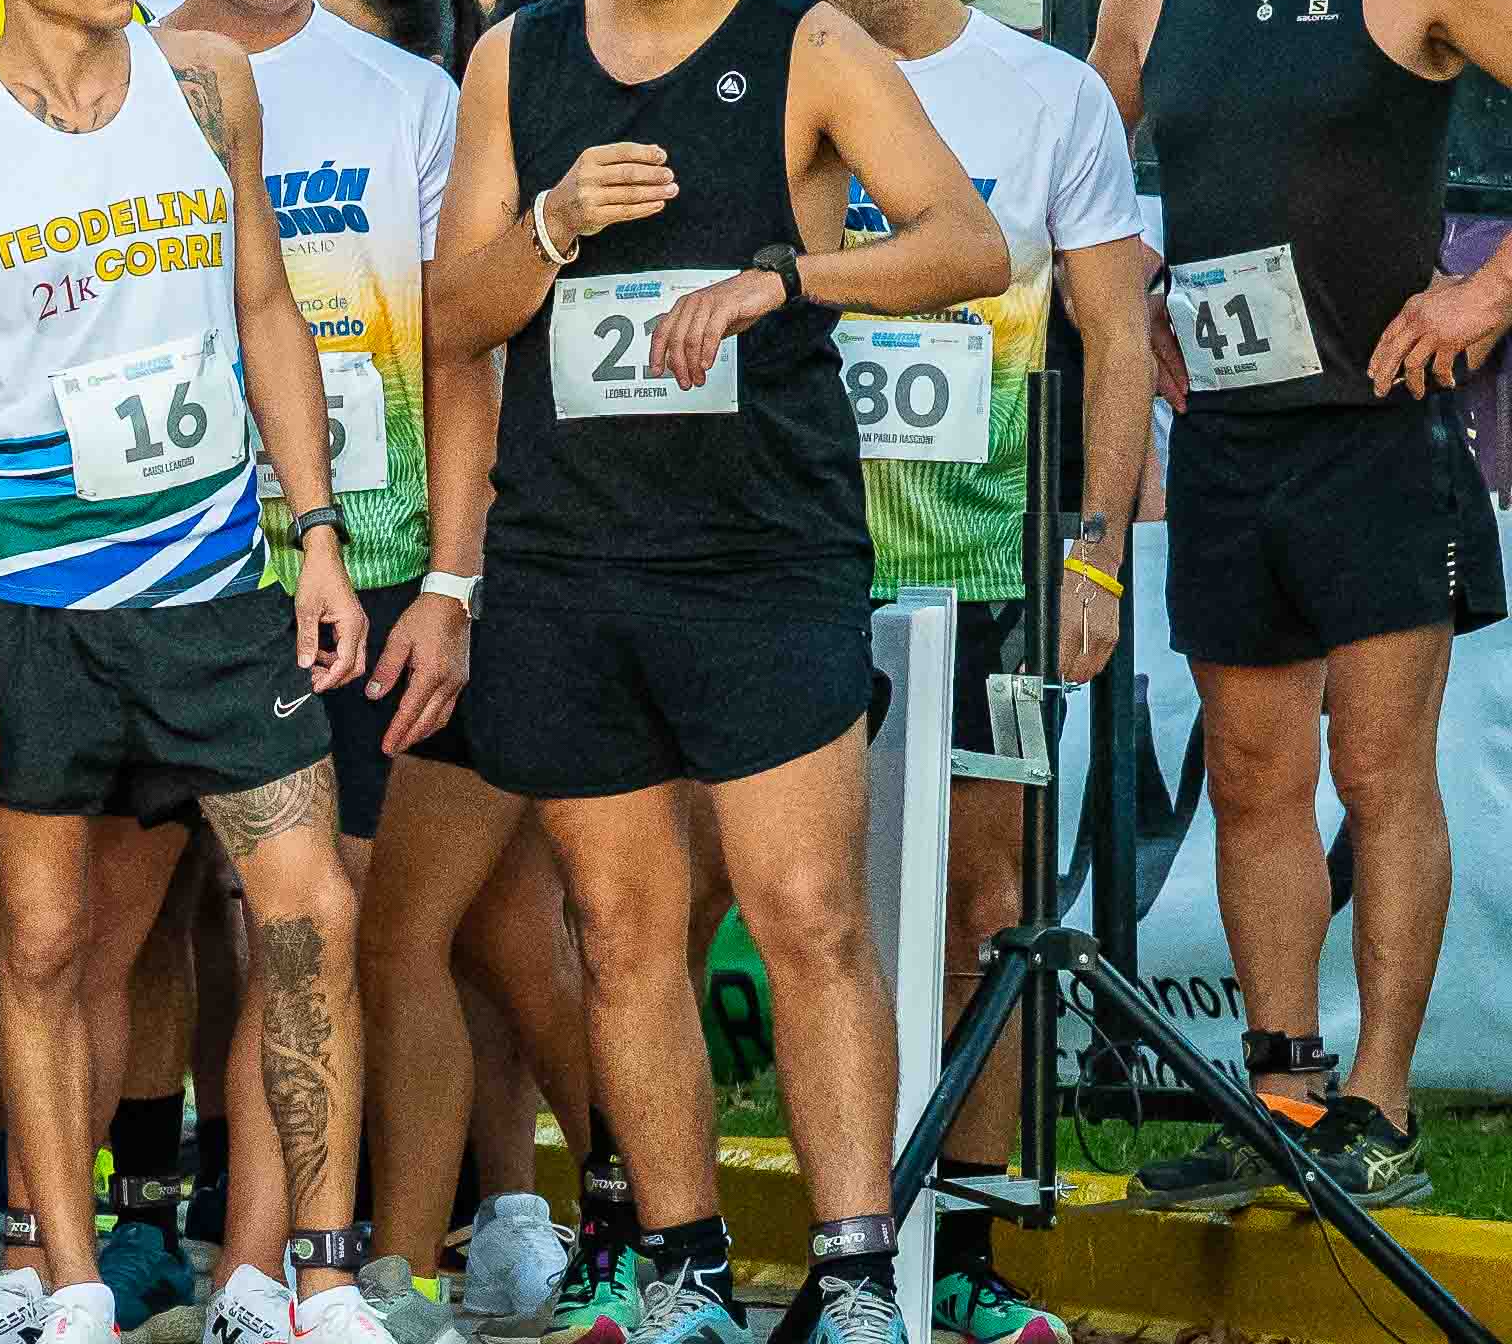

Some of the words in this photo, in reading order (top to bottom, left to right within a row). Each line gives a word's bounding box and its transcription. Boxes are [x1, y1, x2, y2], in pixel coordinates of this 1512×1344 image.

[1195, 293, 1272, 360] 41
[115, 381, 208, 464] 16
[845, 360, 950, 428] 80
